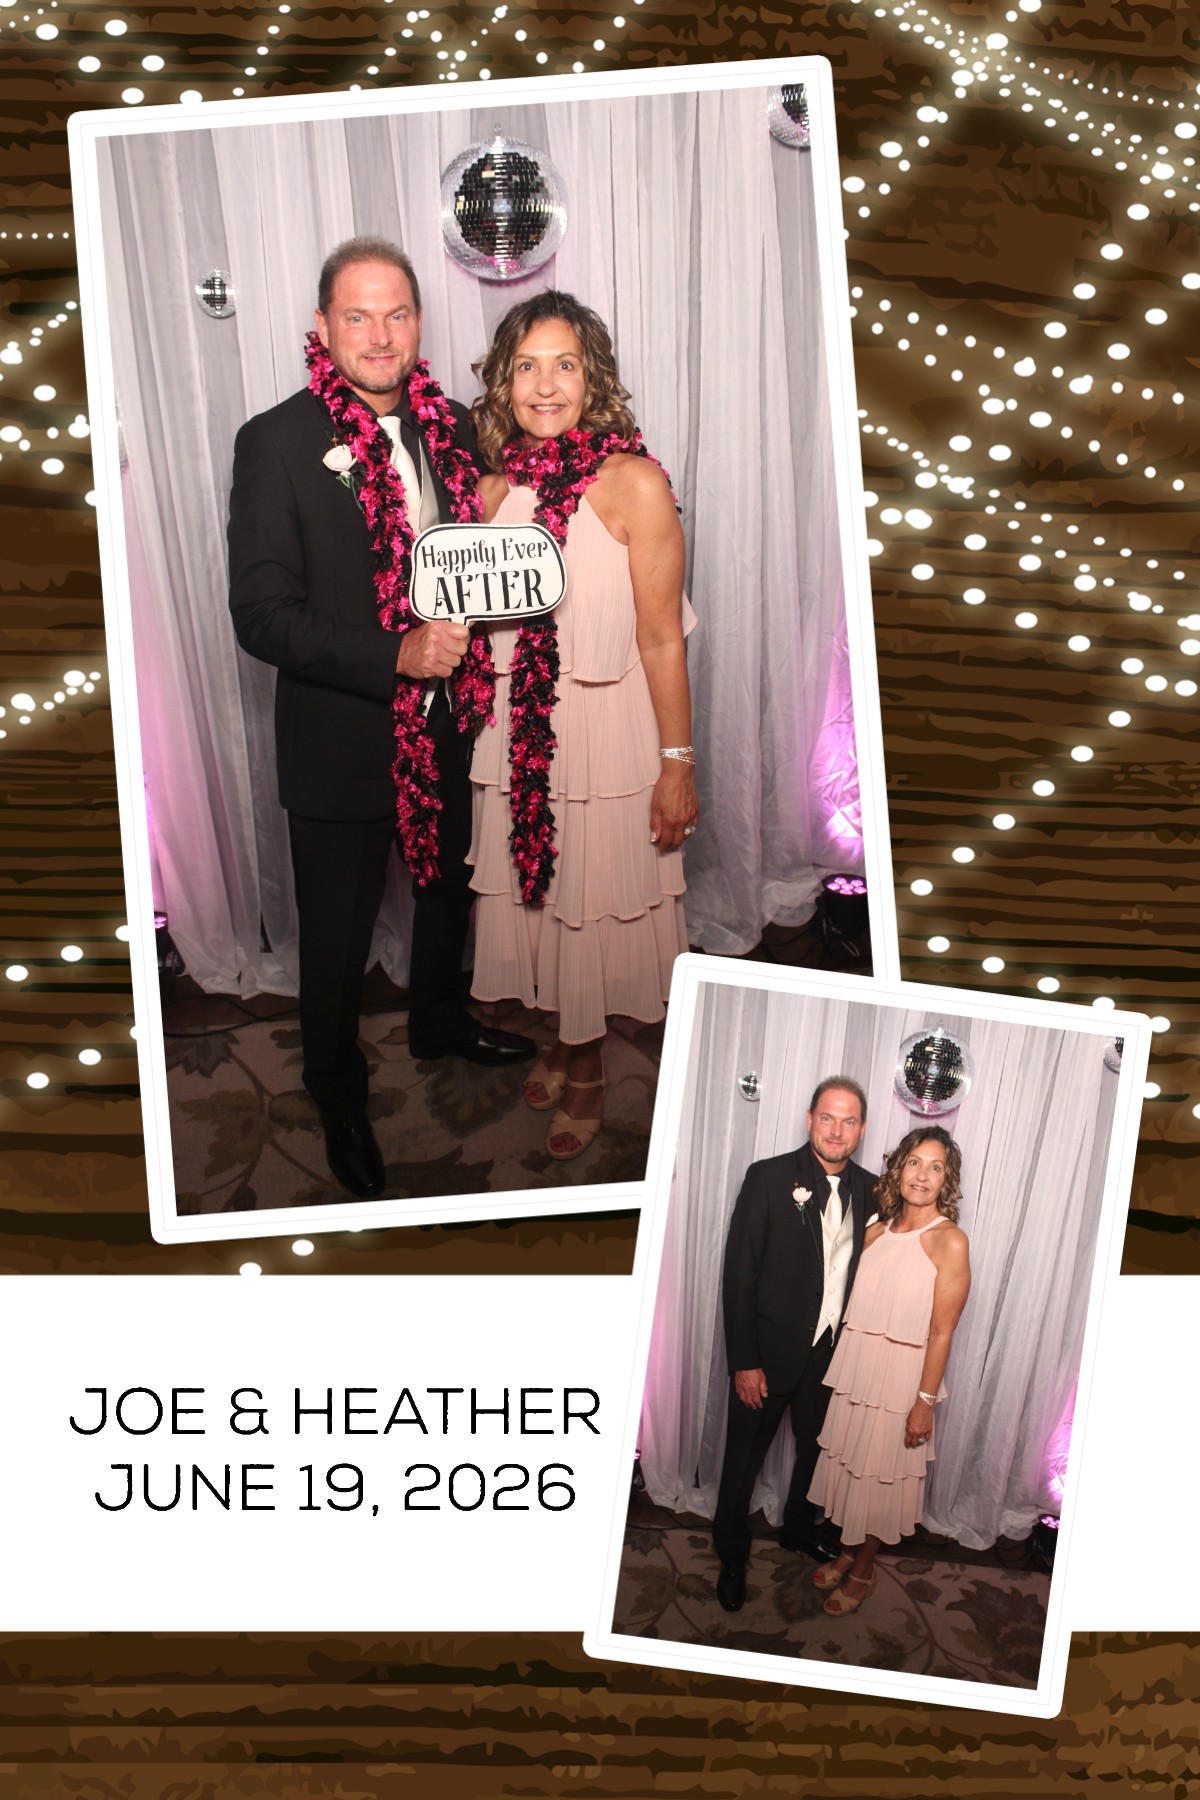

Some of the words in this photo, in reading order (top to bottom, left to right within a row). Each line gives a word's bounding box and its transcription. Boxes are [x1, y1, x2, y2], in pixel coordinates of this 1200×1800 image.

[421, 540, 496, 574] Happily
[501, 537, 548, 562] Ever
[432, 568, 547, 616] AFTER
